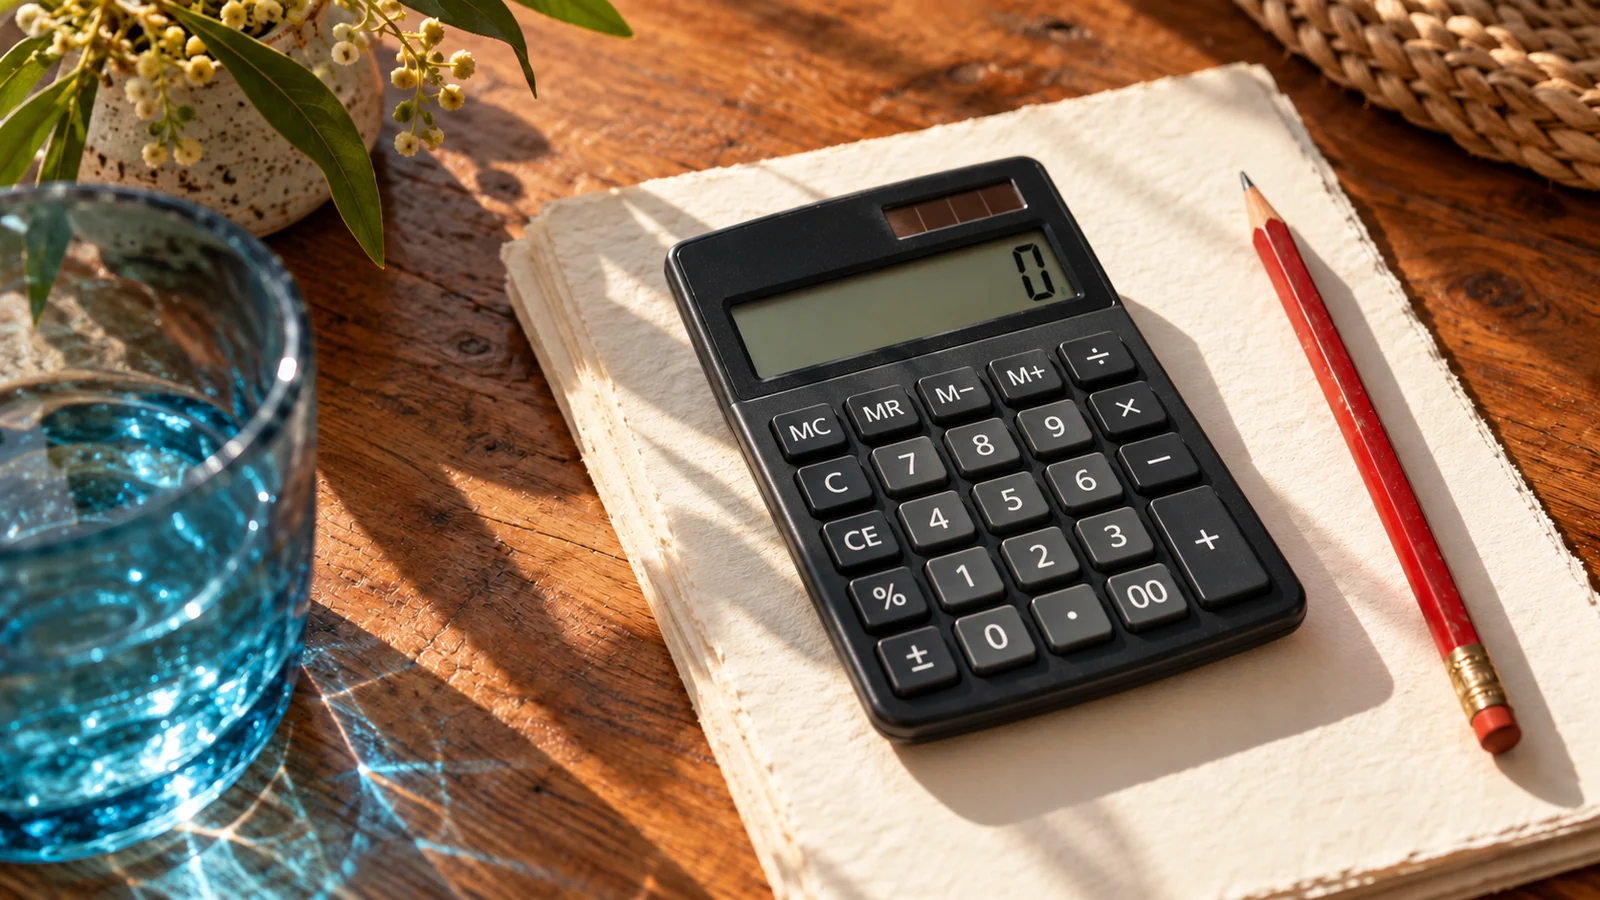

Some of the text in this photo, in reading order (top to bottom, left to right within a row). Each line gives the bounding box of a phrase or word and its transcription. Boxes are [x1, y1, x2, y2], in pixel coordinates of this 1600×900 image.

[1013, 243, 1055, 301] 0
[1006, 365, 1045, 386] M+
[862, 399, 905, 423] MR
[788, 417, 832, 442] MC
[1044, 416, 1065, 438] 9
[972, 434, 995, 456] 8
[897, 452, 915, 475] 7
[824, 471, 849, 493] C
[1075, 468, 1097, 491] 6
[1006, 487, 1023, 511] 5
[929, 507, 949, 529] 4
[844, 525, 883, 551] CE
[1103, 524, 1127, 548] 3
[1029, 544, 1055, 569] 2
[955, 564, 975, 588] 1
[872, 582, 907, 610] %
[1126, 579, 1168, 609] 00
[984, 623, 1008, 650] 0
